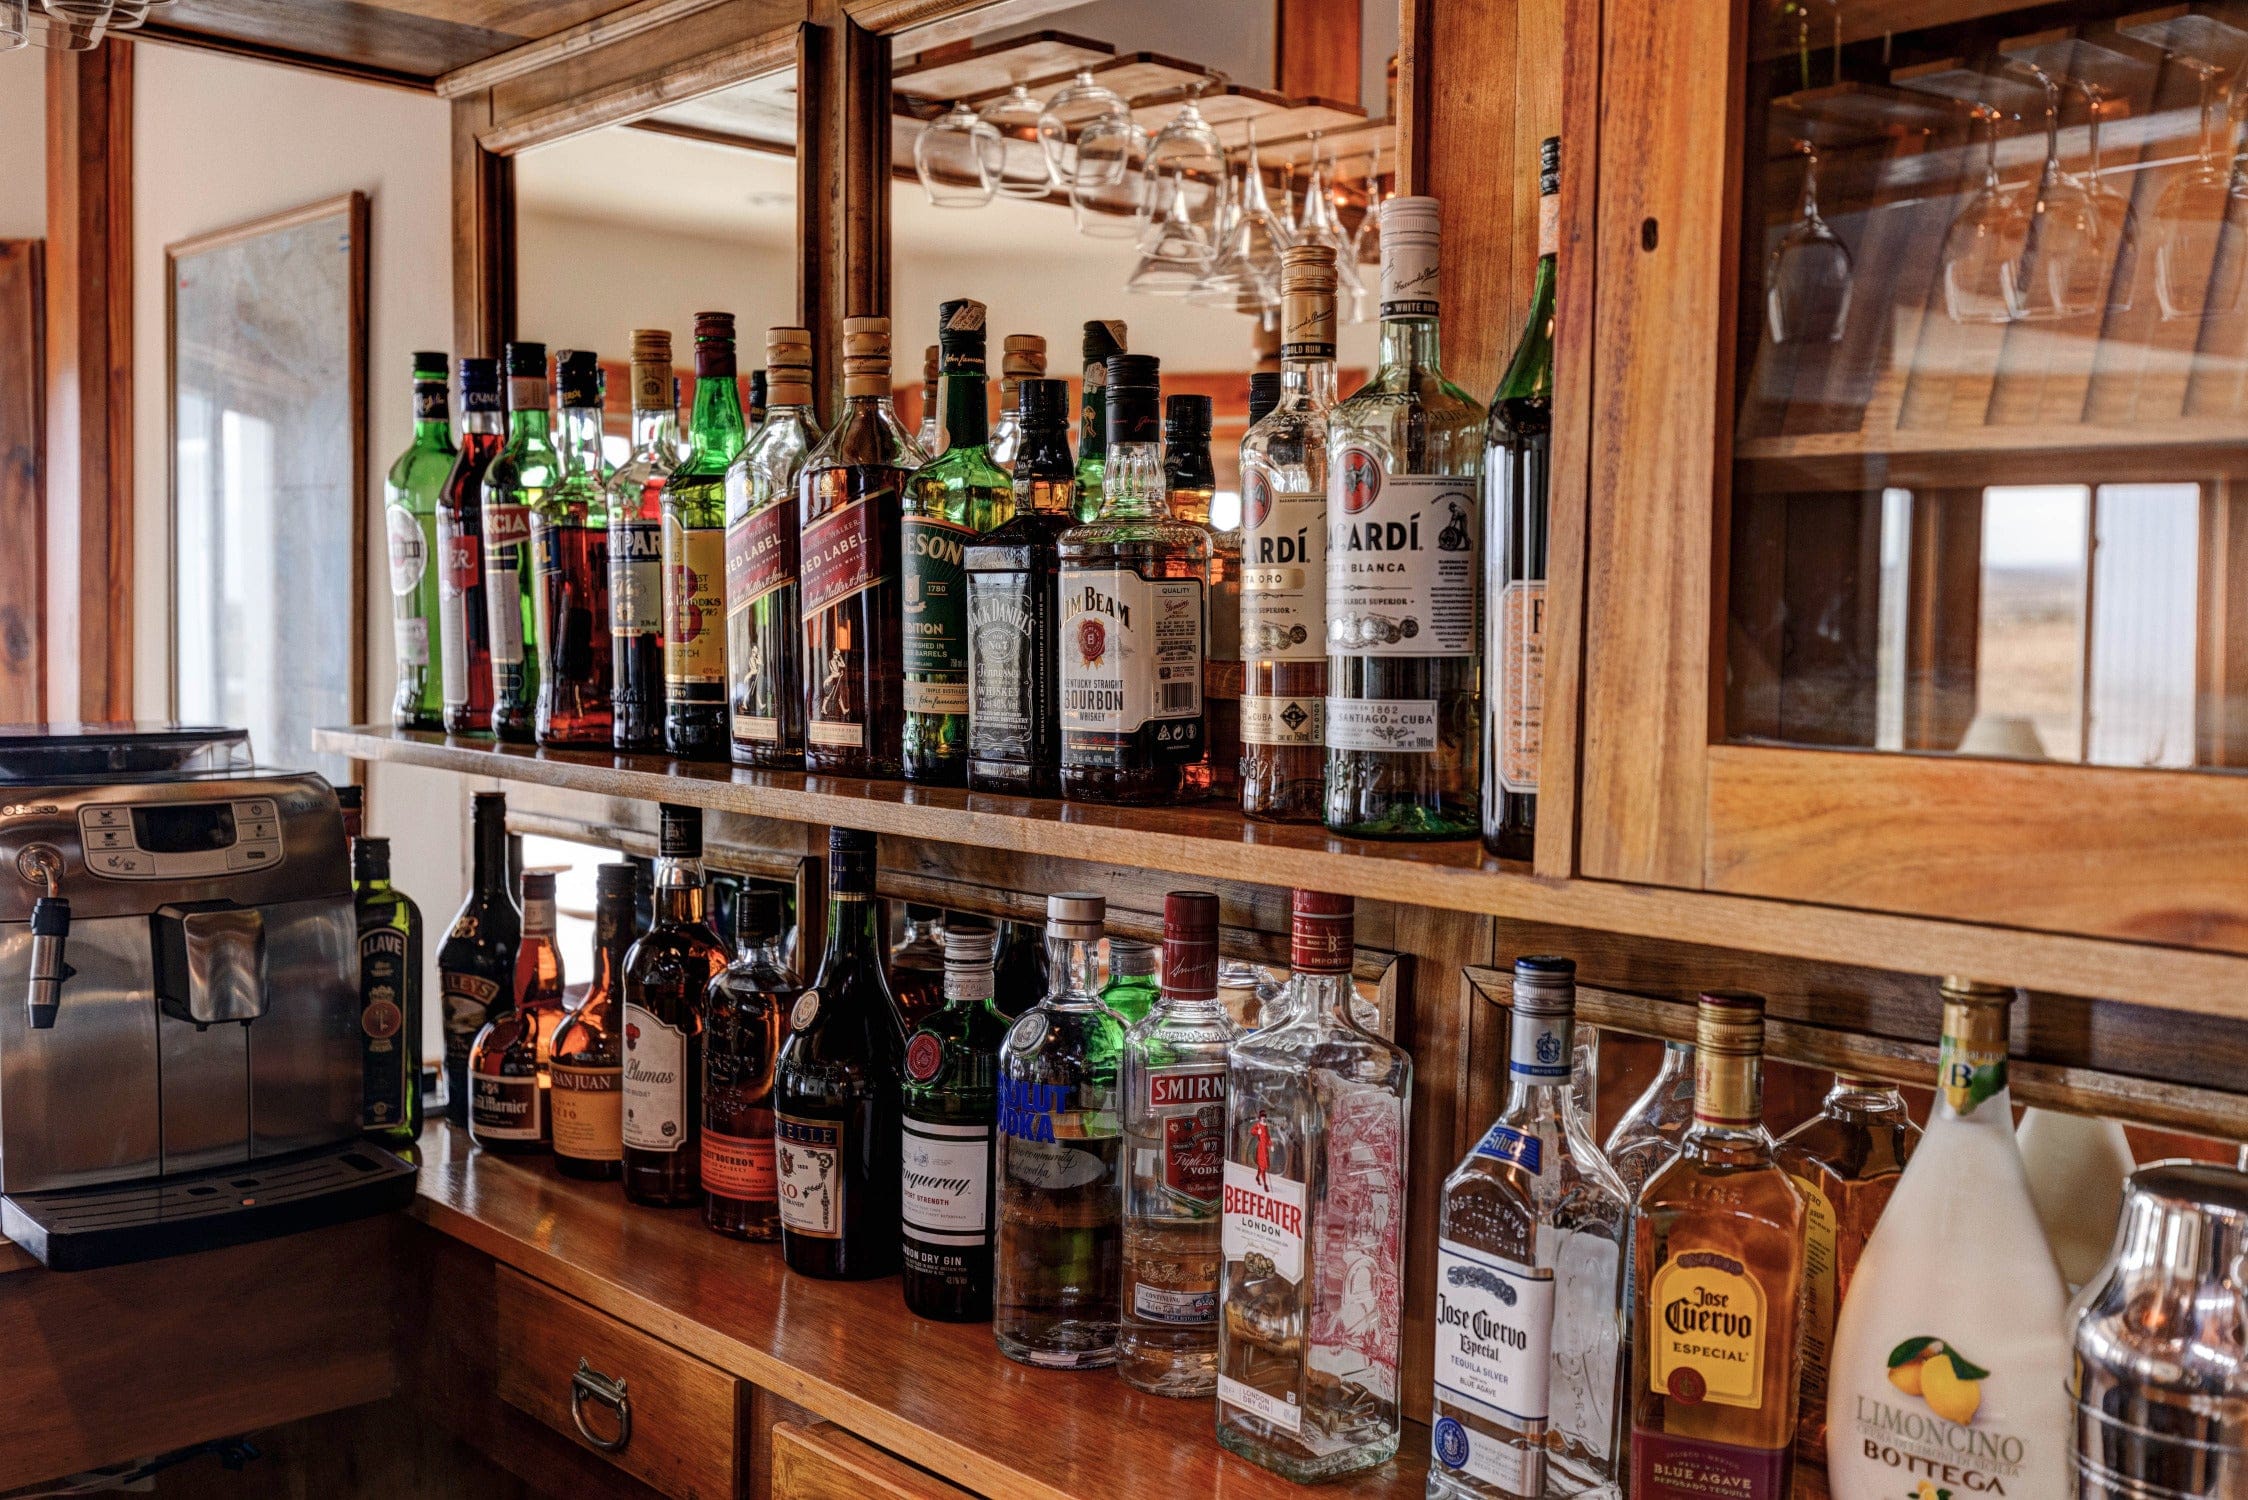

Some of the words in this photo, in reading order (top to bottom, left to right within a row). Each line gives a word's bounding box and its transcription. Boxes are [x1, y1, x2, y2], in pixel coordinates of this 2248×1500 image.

[1395, 302, 1421, 312] WHITE
[1305, 345, 1321, 354] RUM
[744, 533, 781, 560] LABEL
[801, 556, 821, 576] RED
[824, 532, 867, 561] LABEL
[1351, 563, 1406, 573] BLANCA
[1084, 586, 1132, 631] BEAM
[1094, 680, 1124, 688] STRAIGHT
[1064, 690, 1124, 711] BOURBON
[1371, 706, 1398, 714] 1862
[1080, 712, 1106, 721] WHISKEY
[1253, 713, 1273, 721] CUBA
[1339, 714, 1388, 724] SANTIAGO
[1401, 715, 1433, 724] CUBA
[363, 935, 402, 957] LLAVE
[625, 1058, 675, 1084] Plumas
[1951, 1063, 1972, 1088] B
[554, 1072, 573, 1087] SAN
[574, 1074, 611, 1092] JUAN
[1155, 1077, 1225, 1101] SMIRN
[716, 1153, 754, 1167] BOURBON
[1171, 1153, 1200, 1172] Triple
[917, 1195, 950, 1206] STRENGTH
[1224, 1184, 1303, 1240] BEEFEATER
[1242, 1217, 1281, 1238] LONDON
[922, 1252, 940, 1264] DRY
[943, 1256, 962, 1266] GIN
[1693, 1286, 1729, 1308] Jose
[1437, 1293, 1470, 1329] Jose
[1472, 1309, 1527, 1351] Cuervo
[1664, 1297, 1752, 1339] Cuervo
[1460, 1333, 1499, 1361] Especial
[1673, 1342, 1747, 1362] ESPECIAL
[1451, 1354, 1482, 1374] TEQUILA
[1483, 1368, 1509, 1385] SILVER
[1243, 1388, 1270, 1405] LONDON
[1459, 1377, 1475, 1389] BLUE
[1476, 1384, 1497, 1398] AGAVE
[1242, 1396, 1256, 1406] DRY
[1257, 1403, 1270, 1412] GIN
[1856, 1395, 2024, 1465] LIMONCINO
[1653, 1463, 1694, 1480] BLUE
[1700, 1473, 1752, 1490] AGAVE
[1863, 1438, 2006, 1497] BOTTEGA
[1654, 1476, 1707, 1491] REPOSADO
[1709, 1486, 1751, 1499] TEQUILA
